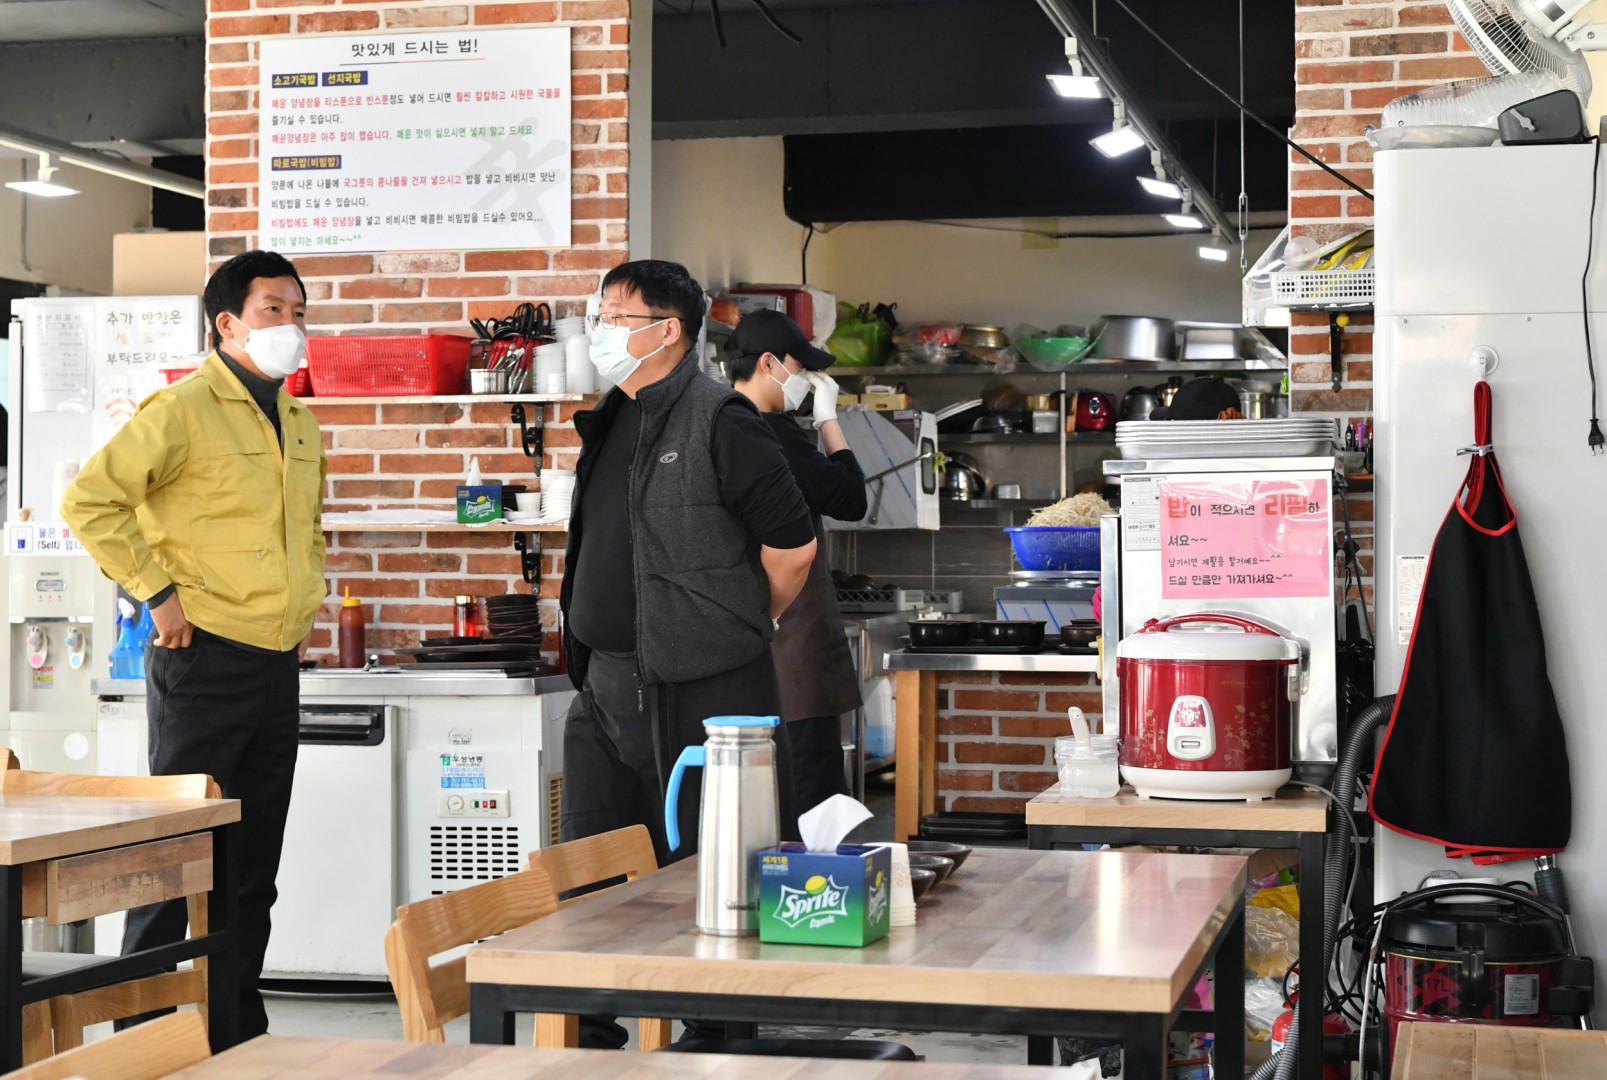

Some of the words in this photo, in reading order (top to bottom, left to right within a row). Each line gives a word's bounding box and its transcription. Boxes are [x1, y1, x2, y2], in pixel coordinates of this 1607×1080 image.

[352, 42, 394, 57] 맛있게
[404, 40, 448, 54] 드시는
[459, 39, 477, 53] 법!
[273, 75, 316, 86] 소고기국밥
[328, 73, 361, 84] 선지국밥
[272, 99, 285, 108] 매운
[292, 98, 320, 108] 양념장을
[325, 96, 361, 106] 티스푼으로
[410, 94, 423, 104] 넣어
[429, 93, 451, 102] 드시면
[511, 89, 533, 99] 시원한
[538, 88, 560, 98] 국물을
[272, 116, 293, 125] 즐기실
[299, 115, 305, 124] 수
[310, 114, 342, 124] 있습니다.
[322, 132, 335, 141] 아주
[341, 132, 354, 141] 많이
[359, 131, 391, 141] 맵습니다.
[397, 129, 411, 139] 매운
[416, 129, 430, 138] 맛이
[436, 128, 465, 138] 싫으시면
[471, 128, 485, 137] 넣지
[490, 127, 504, 136] 말고
[510, 125, 535, 136] 드세요.
[273, 157, 340, 168] 따로국밥(비빔밥)
[272, 180, 293, 190] 양푼에
[299, 180, 312, 189] 나온
[317, 179, 339, 189] 나물에
[344, 178, 373, 187] 국그릇의
[378, 176, 407, 187] 콩나물을
[413, 176, 426, 186] 건져
[432, 176, 461, 185] 넣으시고
[466, 174, 480, 184] 밥을
[486, 174, 500, 184] 넣고
[505, 173, 535, 183] 비비시면
[541, 172, 555, 182] 맛난
[272, 199, 300, 209] 비빔밥을
[306, 199, 320, 208] 드실
[325, 198, 331, 207] 수
[336, 198, 368, 207] 있습니다.
[272, 218, 308, 228] 비빔밥에도
[313, 217, 327, 227] 매운
[333, 216, 361, 227] 양념장을
[366, 216, 380, 226] 넣고
[386, 215, 415, 224] 비비시면
[421, 214, 443, 224] 매콤한
[448, 213, 478, 223] 비빔밥을
[483, 212, 506, 222] 드실수
[511, 212, 542, 221] 있어요...
[107, 311, 133, 325] 추가
[142, 311, 182, 324] 반찬은
[1168, 496, 1200, 518] 밥이
[1211, 504, 1255, 516] 적으시면
[1265, 494, 1320, 515] 리필하
[1168, 558, 1198, 568] 남기시면
[1169, 575, 1186, 586] 드실
[1192, 575, 1221, 585] 만큼만
[782, 889, 840, 920] Sprite
[1426, 978, 1449, 993] 17L
